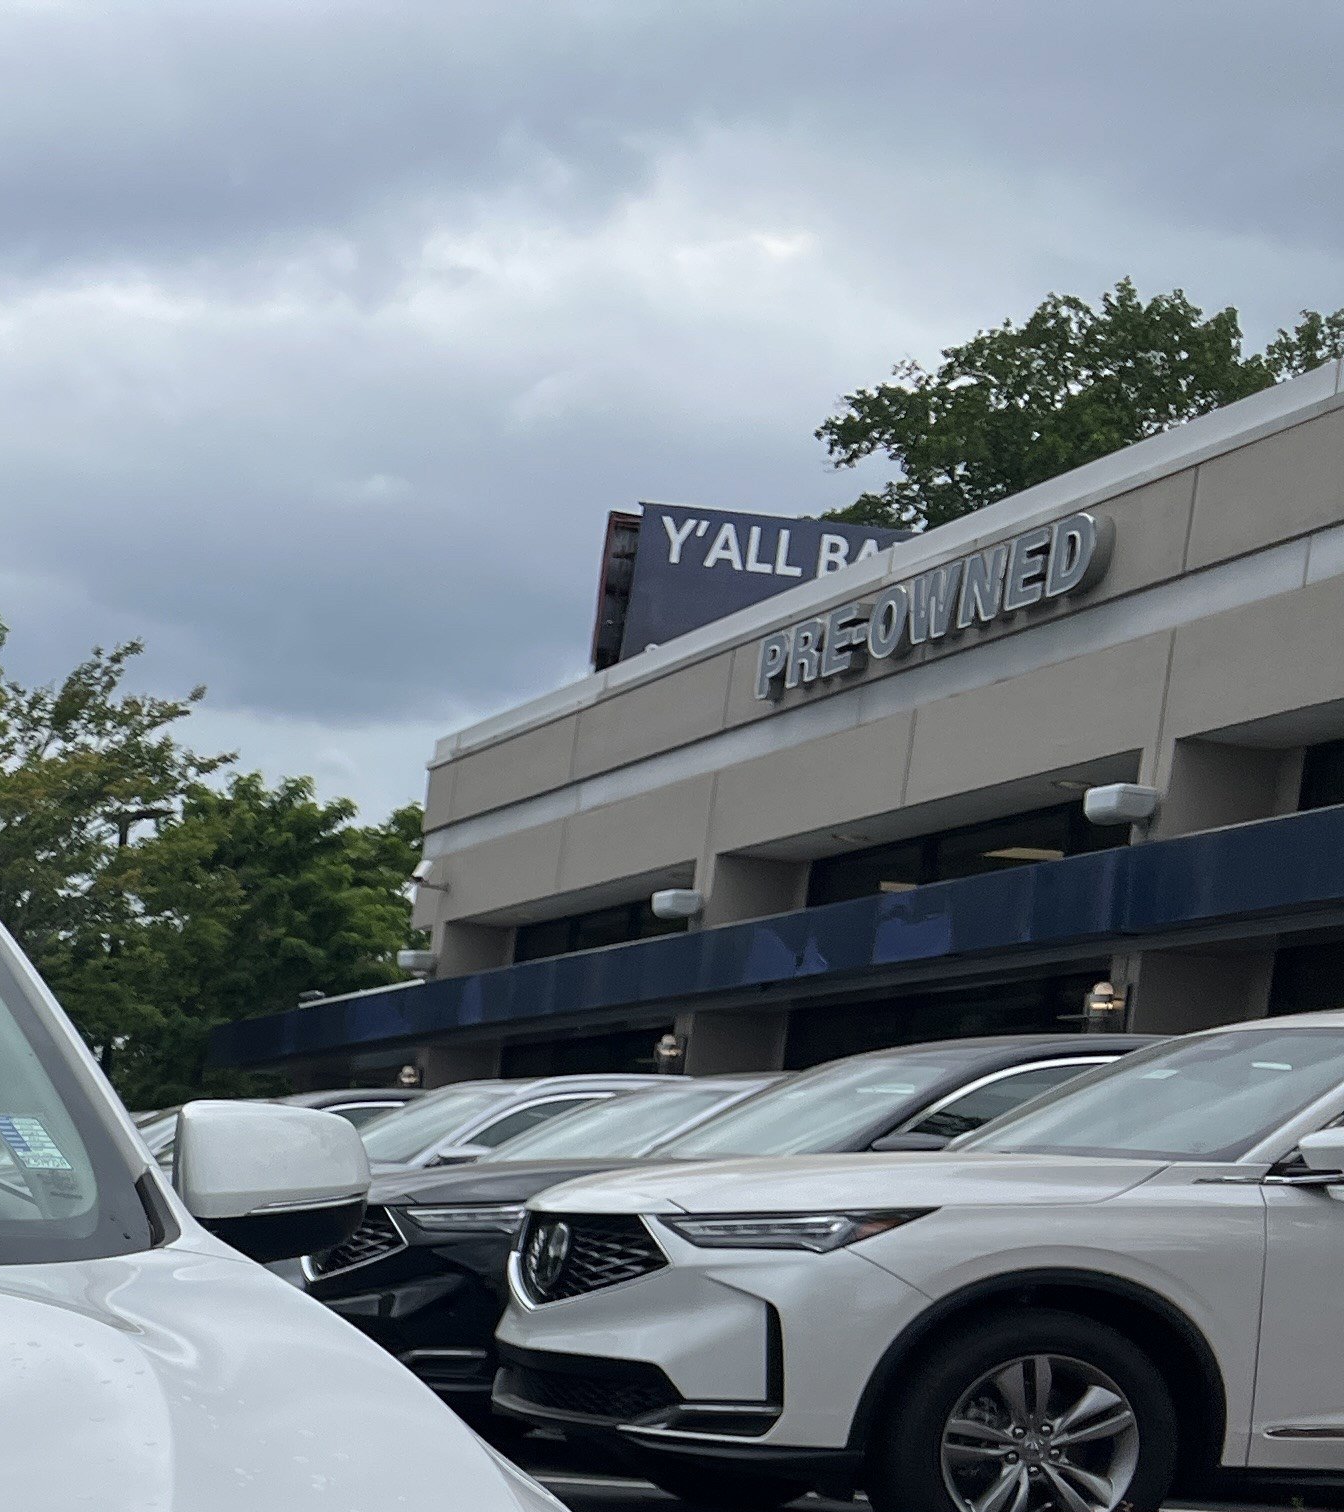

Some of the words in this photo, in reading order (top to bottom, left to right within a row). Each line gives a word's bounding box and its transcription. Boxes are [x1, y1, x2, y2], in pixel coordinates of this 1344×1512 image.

[661, 515, 803, 577] Y'ALL
[816, 533, 902, 579] BA
[754, 511, 1099, 700] PRE-OWNED
